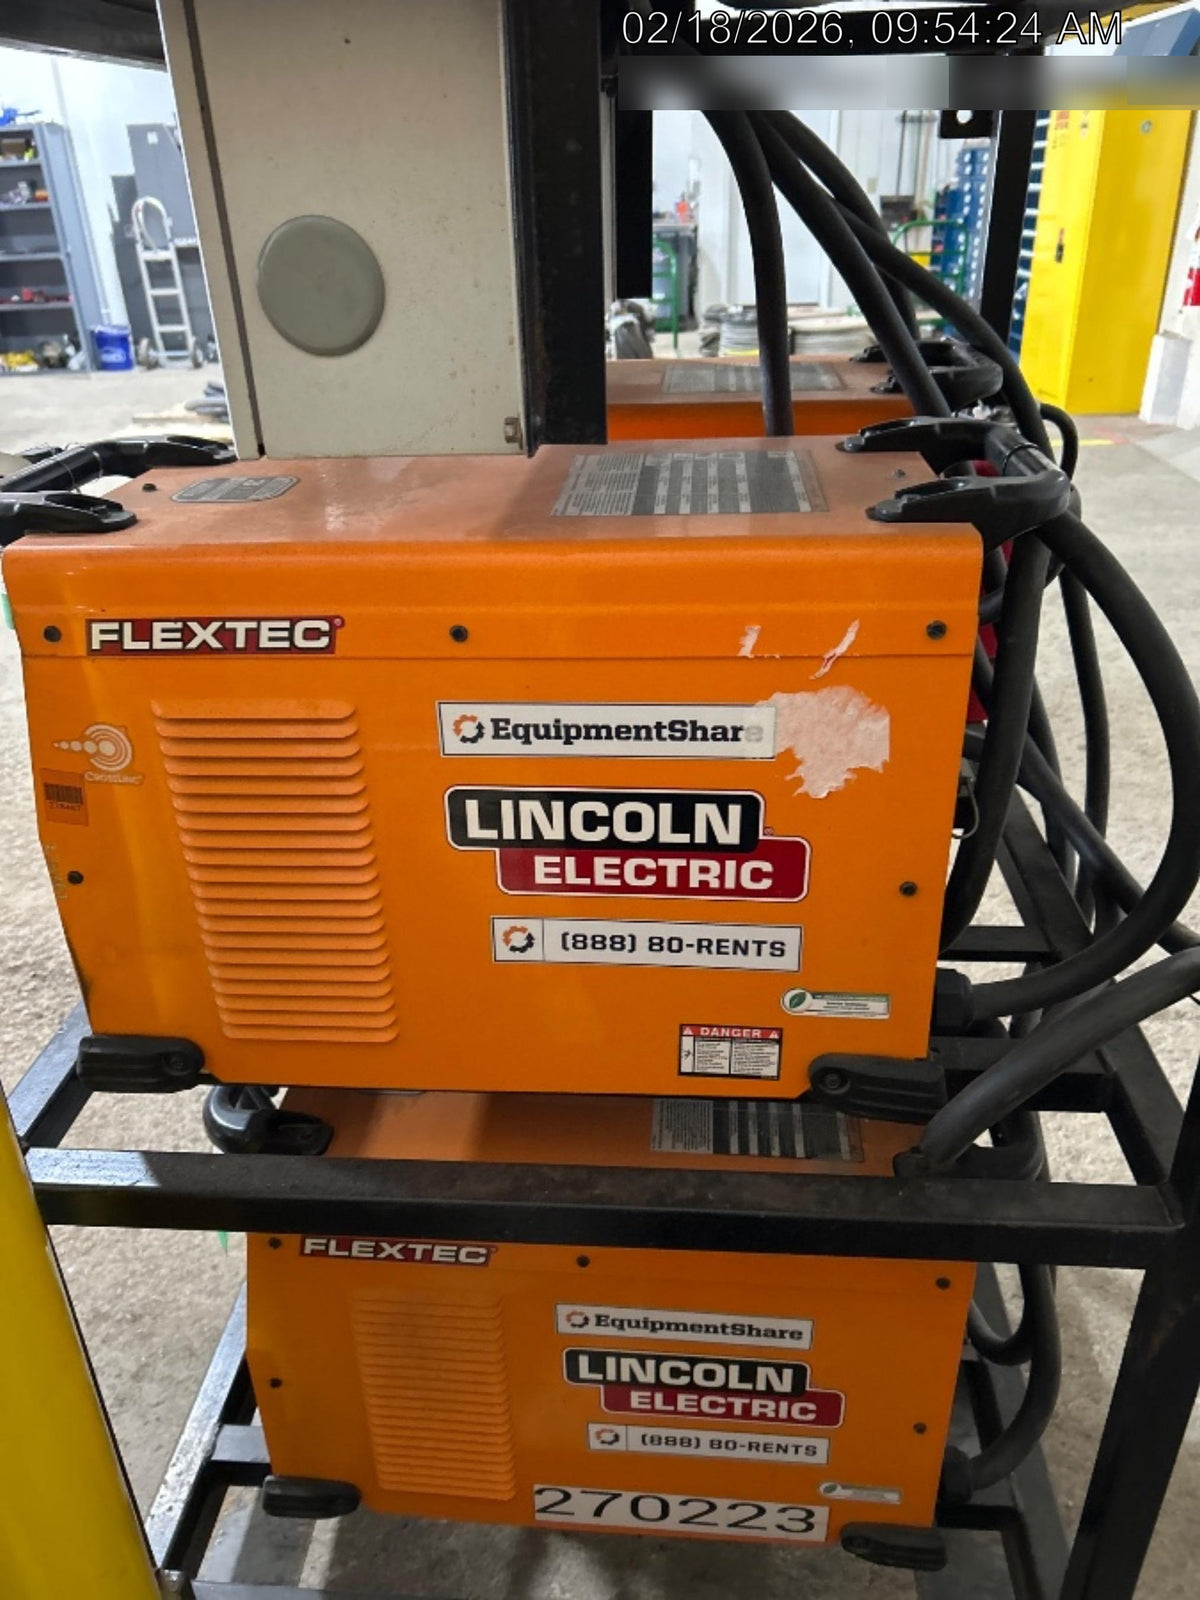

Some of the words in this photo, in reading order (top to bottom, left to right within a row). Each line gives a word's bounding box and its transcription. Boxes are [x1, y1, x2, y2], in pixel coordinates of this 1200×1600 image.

[91, 619, 332, 651] FLEXTEC
[490, 717, 764, 746] EquipmentShare
[465, 798, 742, 845] LINCOLN
[534, 855, 774, 890] ELECTRIC
[561, 932, 637, 953] (888)
[648, 935, 786, 958] 80-RENTS
[699, 1027, 762, 1038] DANGER
[303, 1238, 489, 1264] FLEXTEC
[594, 1314, 803, 1342] EquipmentShare
[578, 1354, 793, 1393] LINCOLN
[630, 1391, 818, 1421] ELECTRIC
[640, 1433, 701, 1450] (888)
[709, 1438, 818, 1457] 80-RENTS
[534, 1487, 816, 1534] 270223
